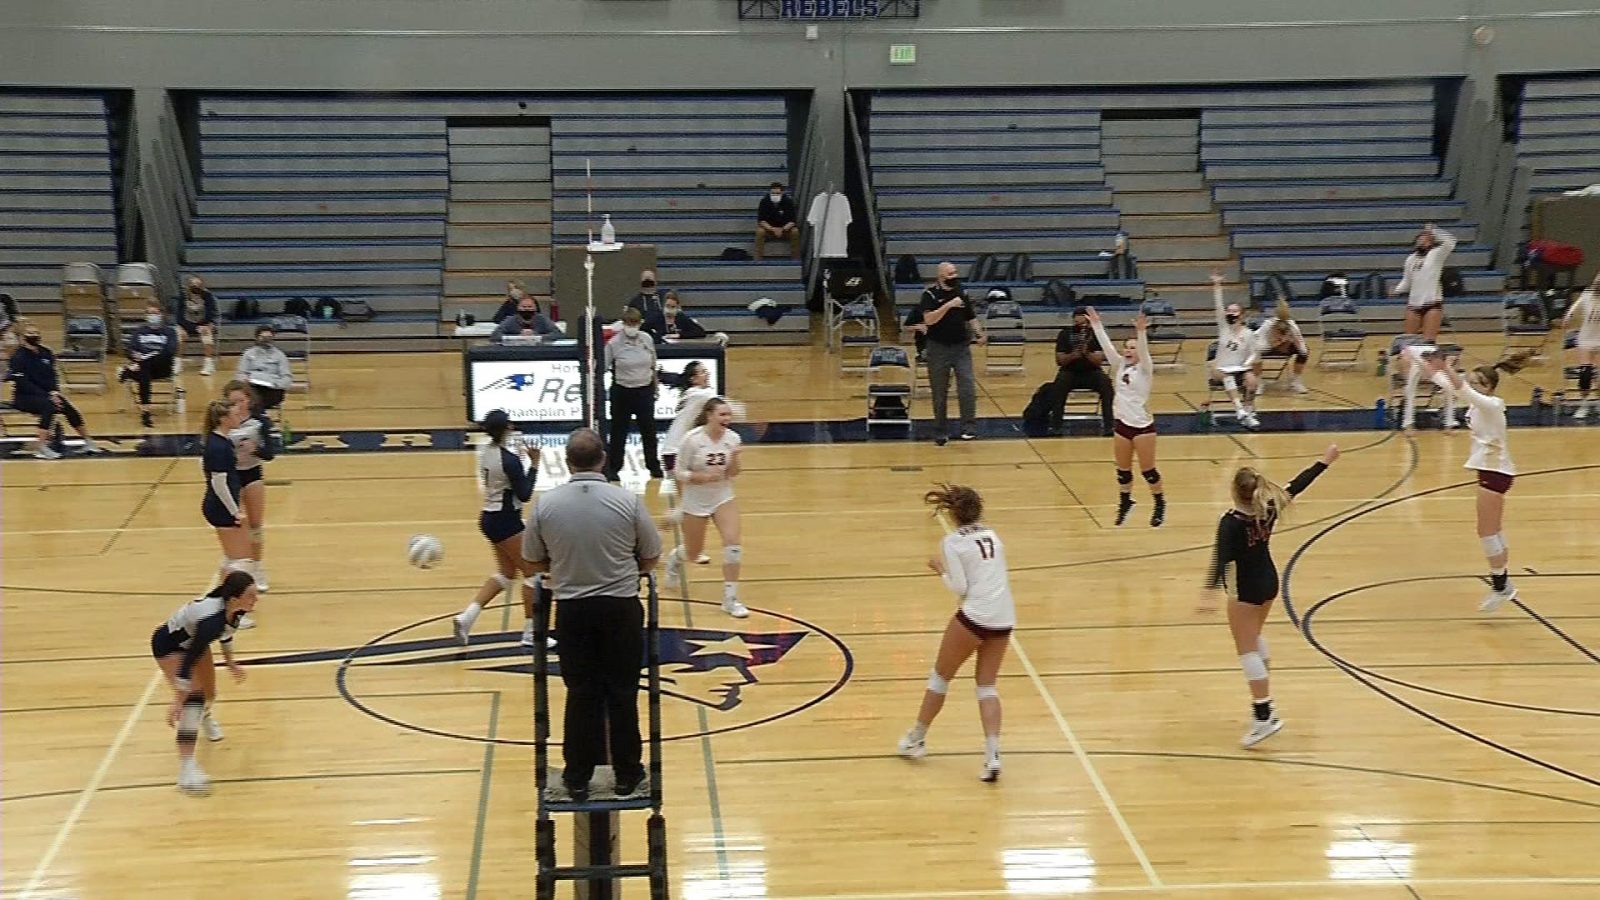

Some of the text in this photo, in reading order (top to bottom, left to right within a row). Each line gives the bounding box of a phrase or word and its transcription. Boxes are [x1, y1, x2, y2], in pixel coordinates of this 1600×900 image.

[780, 0, 879, 17] REBELS
[705, 452, 726, 466] 23
[974, 537, 995, 559] 17
